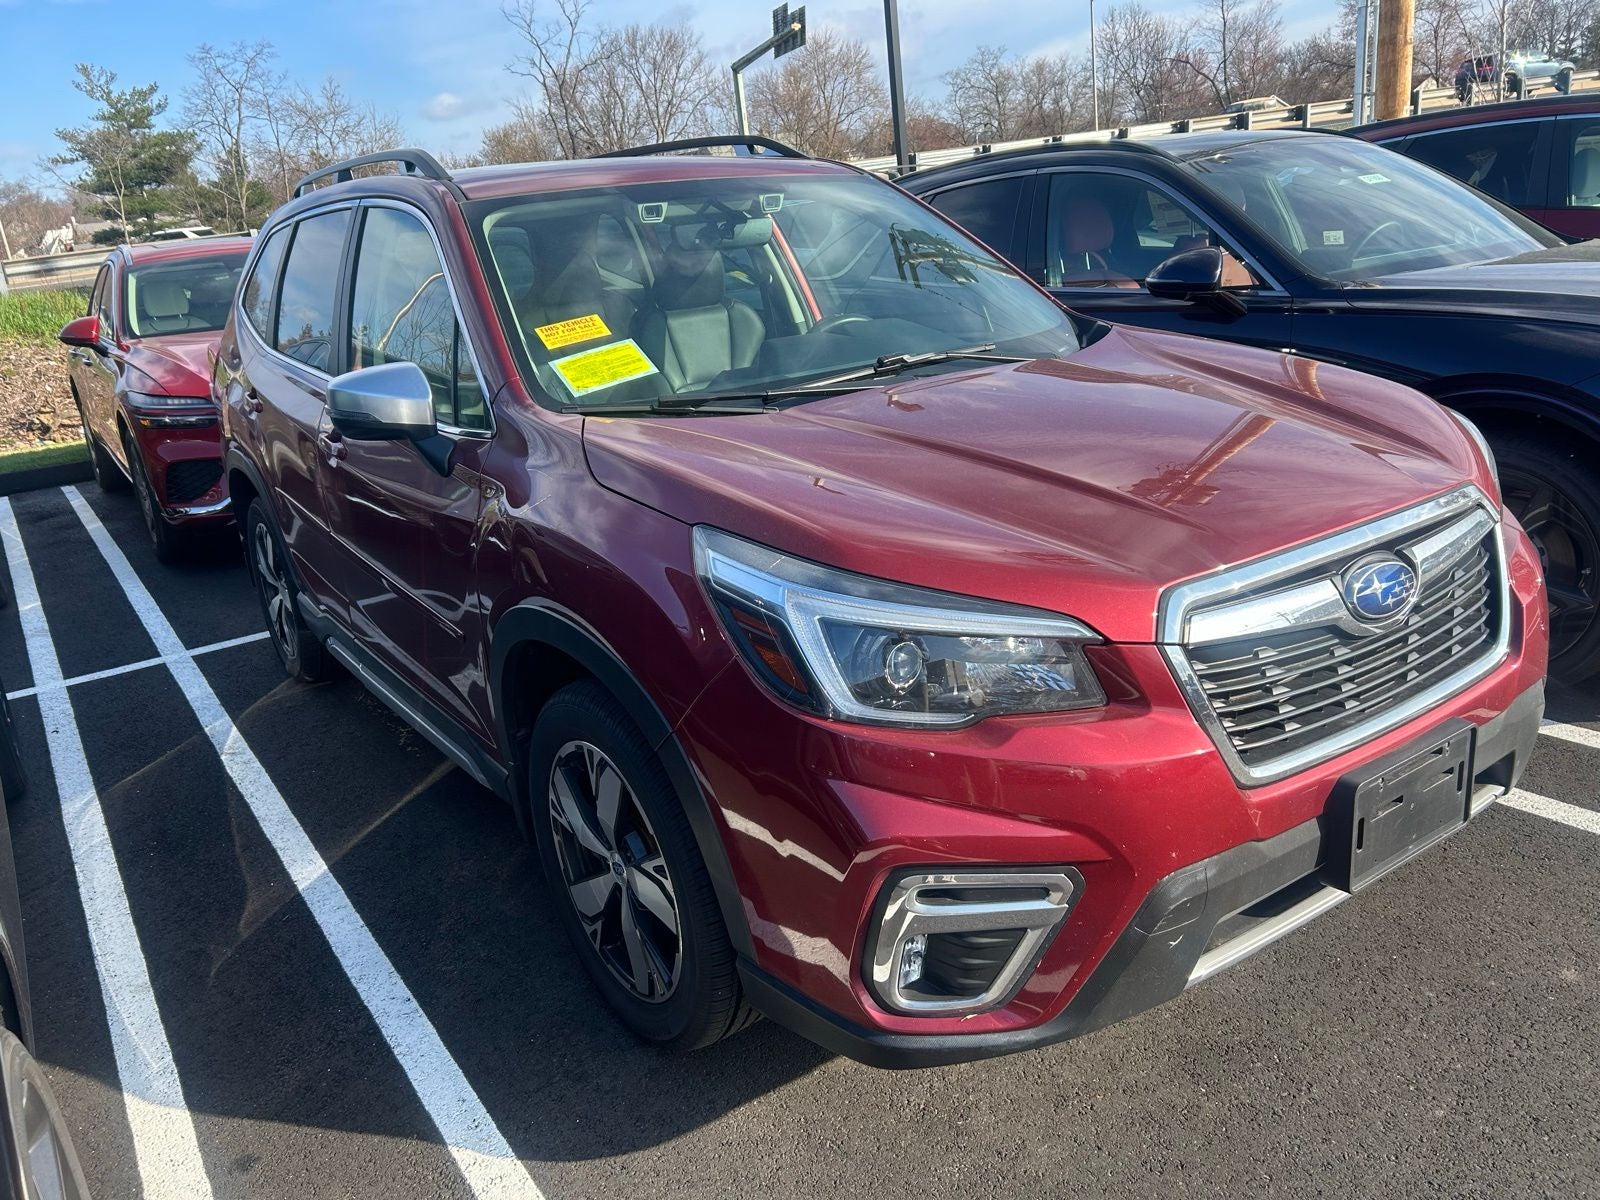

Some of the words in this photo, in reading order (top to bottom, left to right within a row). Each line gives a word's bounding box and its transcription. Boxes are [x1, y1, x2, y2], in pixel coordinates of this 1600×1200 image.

[540, 325, 559, 334] THIS
[560, 316, 596, 329] VEHICLE
[578, 322, 598, 330] SALE
